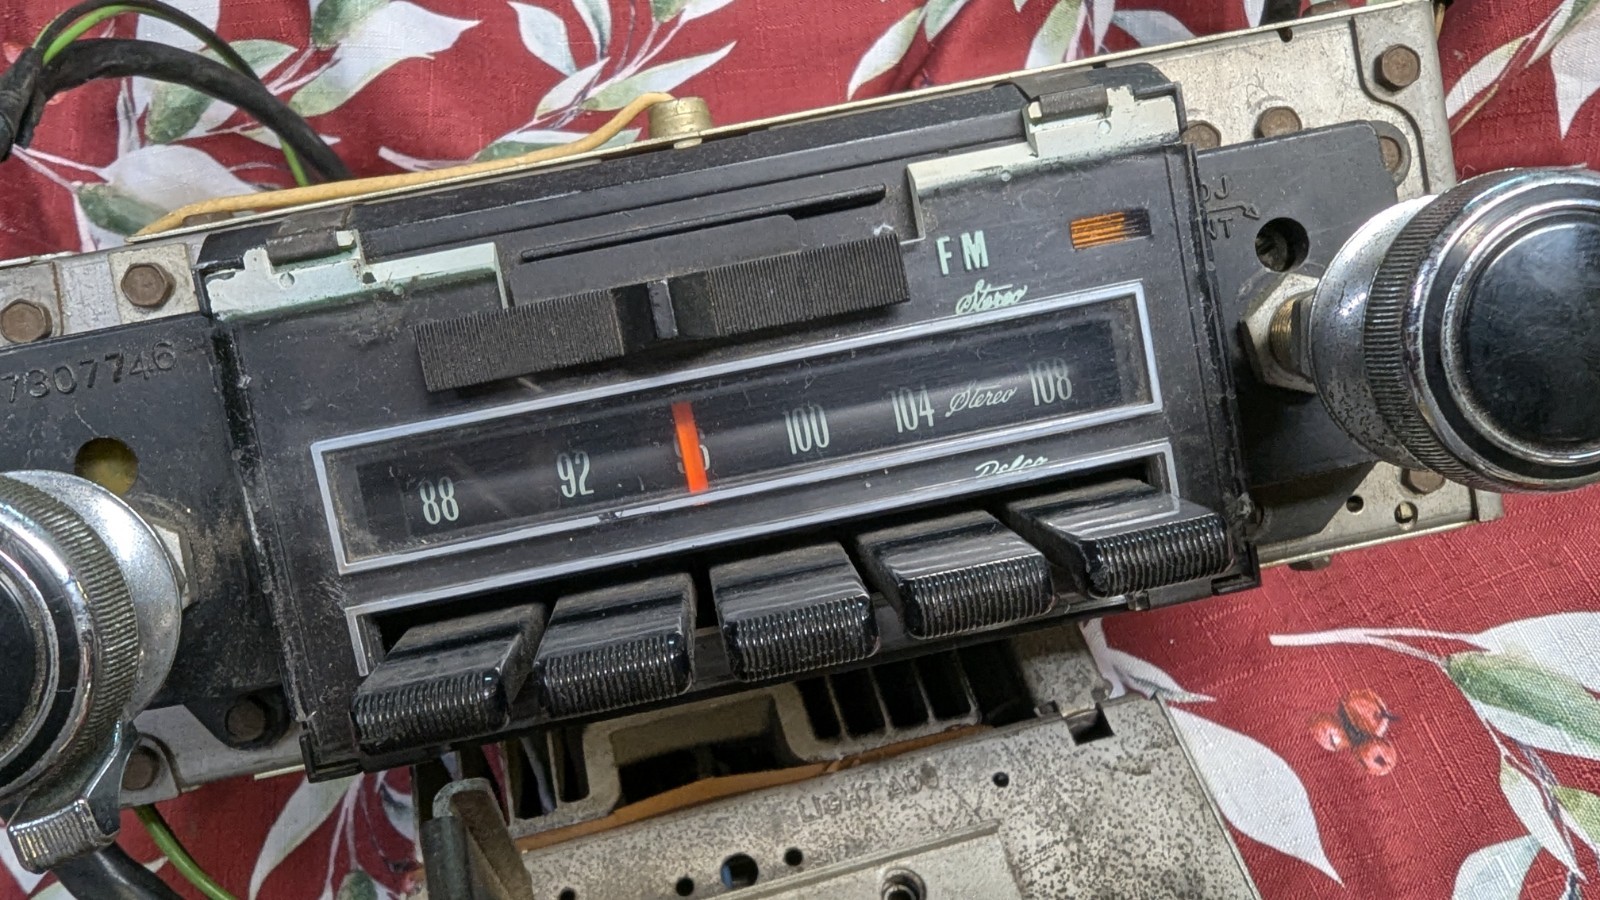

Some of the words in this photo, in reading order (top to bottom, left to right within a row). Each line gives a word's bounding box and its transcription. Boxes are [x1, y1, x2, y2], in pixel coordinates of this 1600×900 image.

[955, 279, 1028, 315] Stereo
[1, 341, 177, 403] 7307746
[418, 475, 460, 525] 88
[556, 450, 594, 498] 92
[783, 401, 830, 455] 100
[890, 383, 935, 433] 104
[945, 380, 1018, 418] Stereo
[1027, 357, 1073, 406] 108
[975, 454, 1049, 479] Delco
